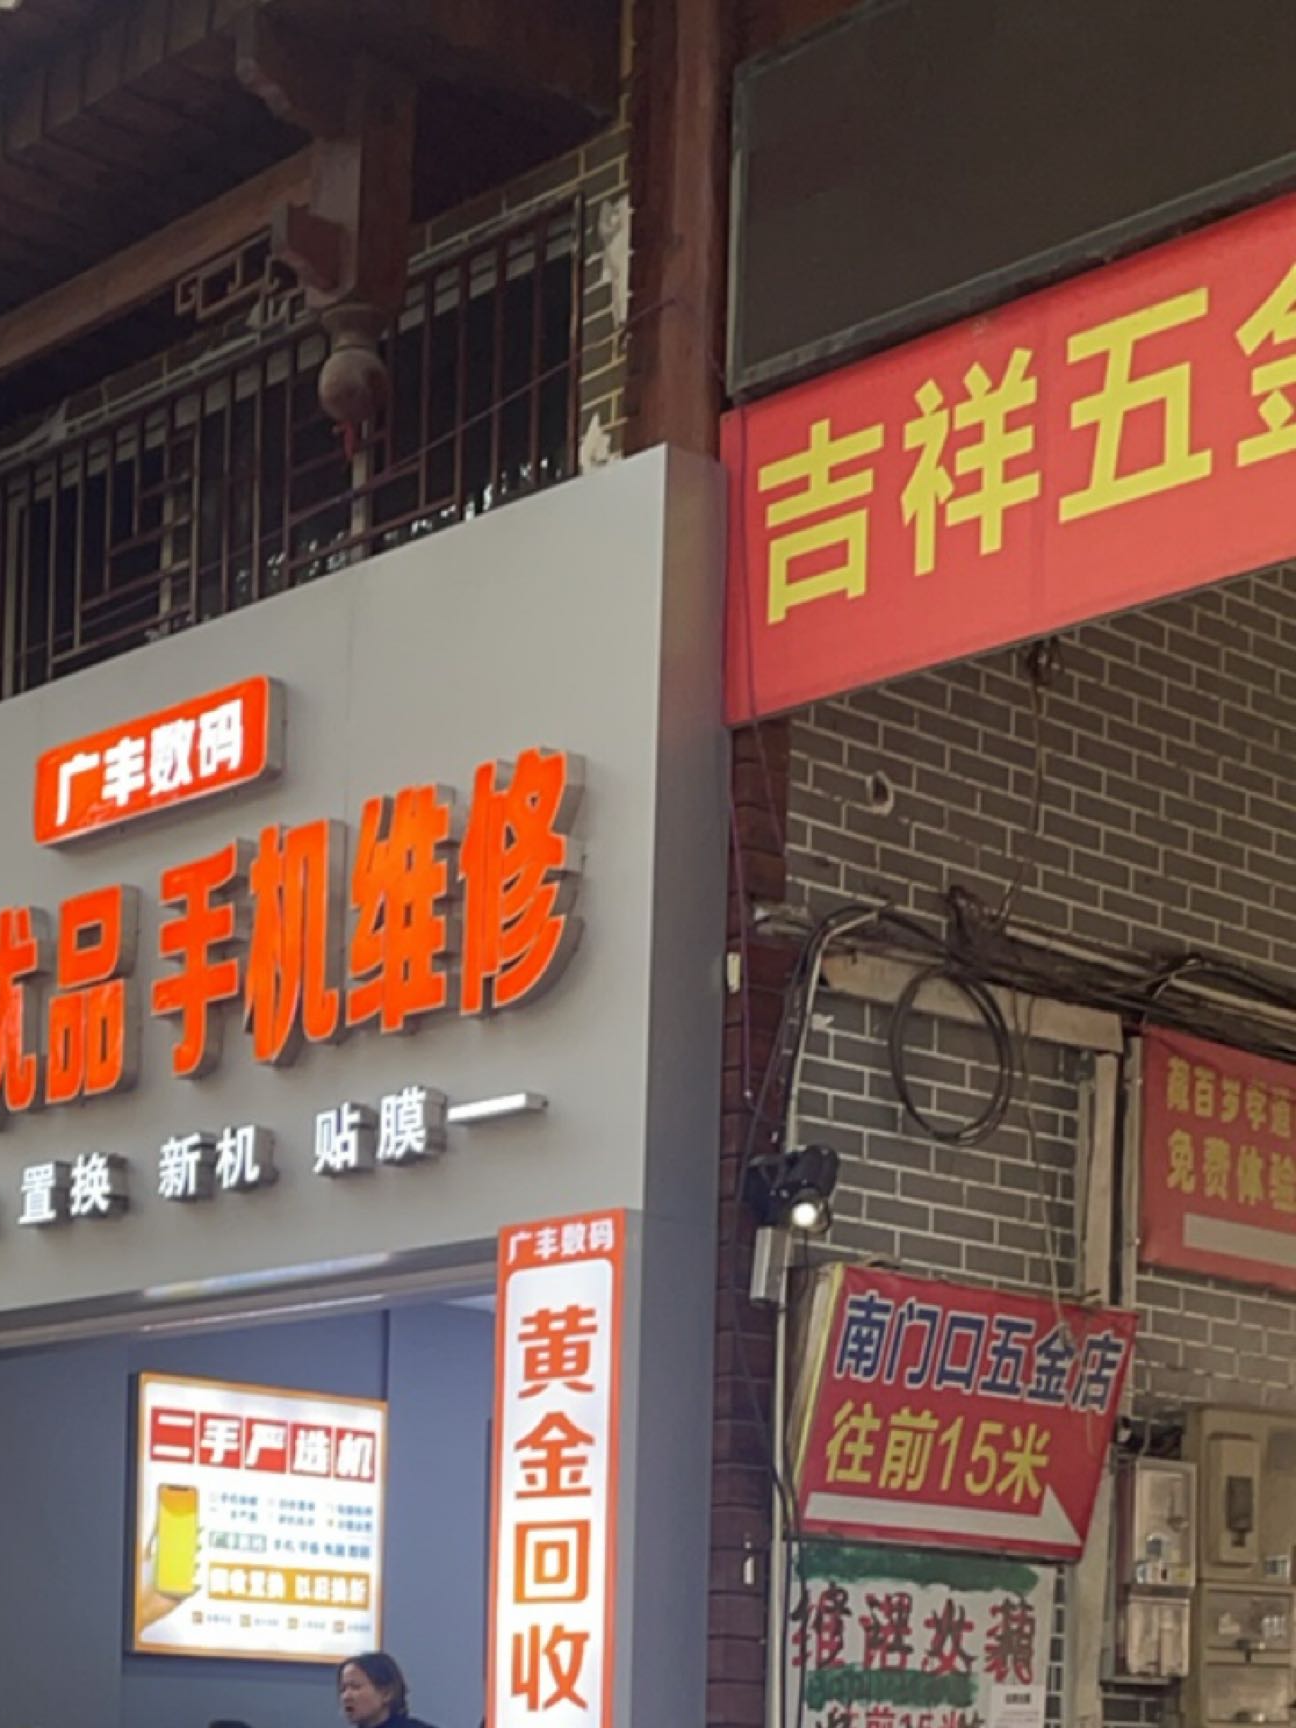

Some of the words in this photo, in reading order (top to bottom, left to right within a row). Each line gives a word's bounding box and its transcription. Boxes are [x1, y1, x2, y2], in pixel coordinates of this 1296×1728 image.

[55, 697, 243, 826] 广丰数码
[151, 747, 572, 1077] 手机维修
[507, 1220, 615, 1263] 广丰数码
[833, 1290, 1123, 1415] 南门口五金店
[510, 1304, 598, 1712] 黄金回收
[825, 1399, 1052, 1504] 往前15米
